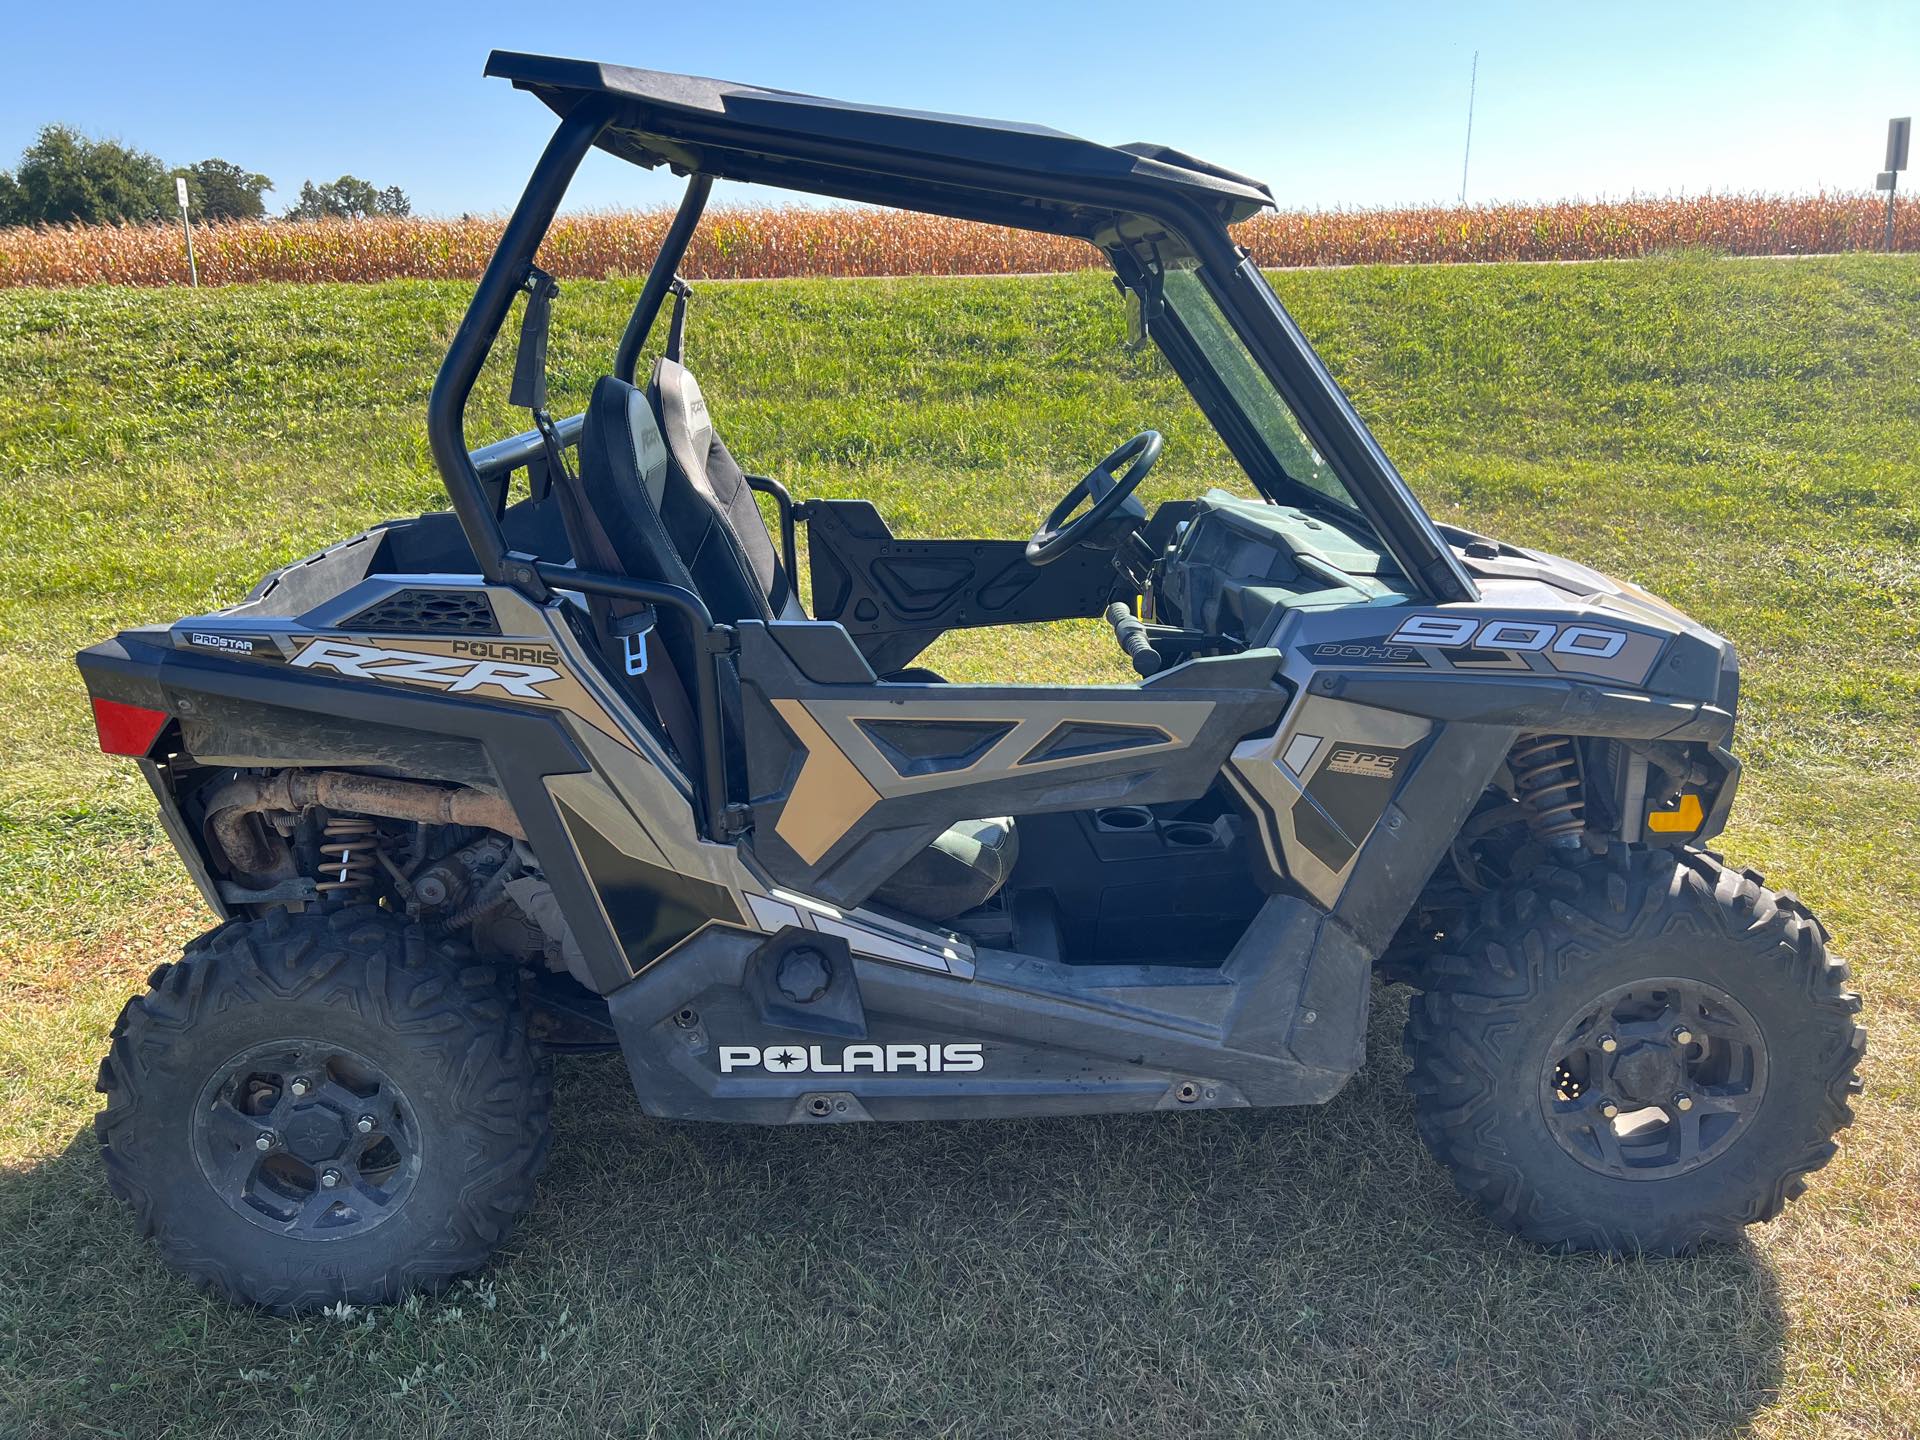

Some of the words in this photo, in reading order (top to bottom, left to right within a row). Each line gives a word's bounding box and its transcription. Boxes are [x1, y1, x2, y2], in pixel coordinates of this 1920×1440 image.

[690, 400, 705, 418] RZR
[193, 633, 253, 651] PROSTAR
[1390, 614, 1627, 659] 900
[452, 639, 559, 665] POLARIS
[1314, 644, 1414, 660] DOHC
[290, 638, 562, 699] RZR
[1331, 750, 1399, 769] EPS
[719, 1043, 984, 1073] POLARIS
